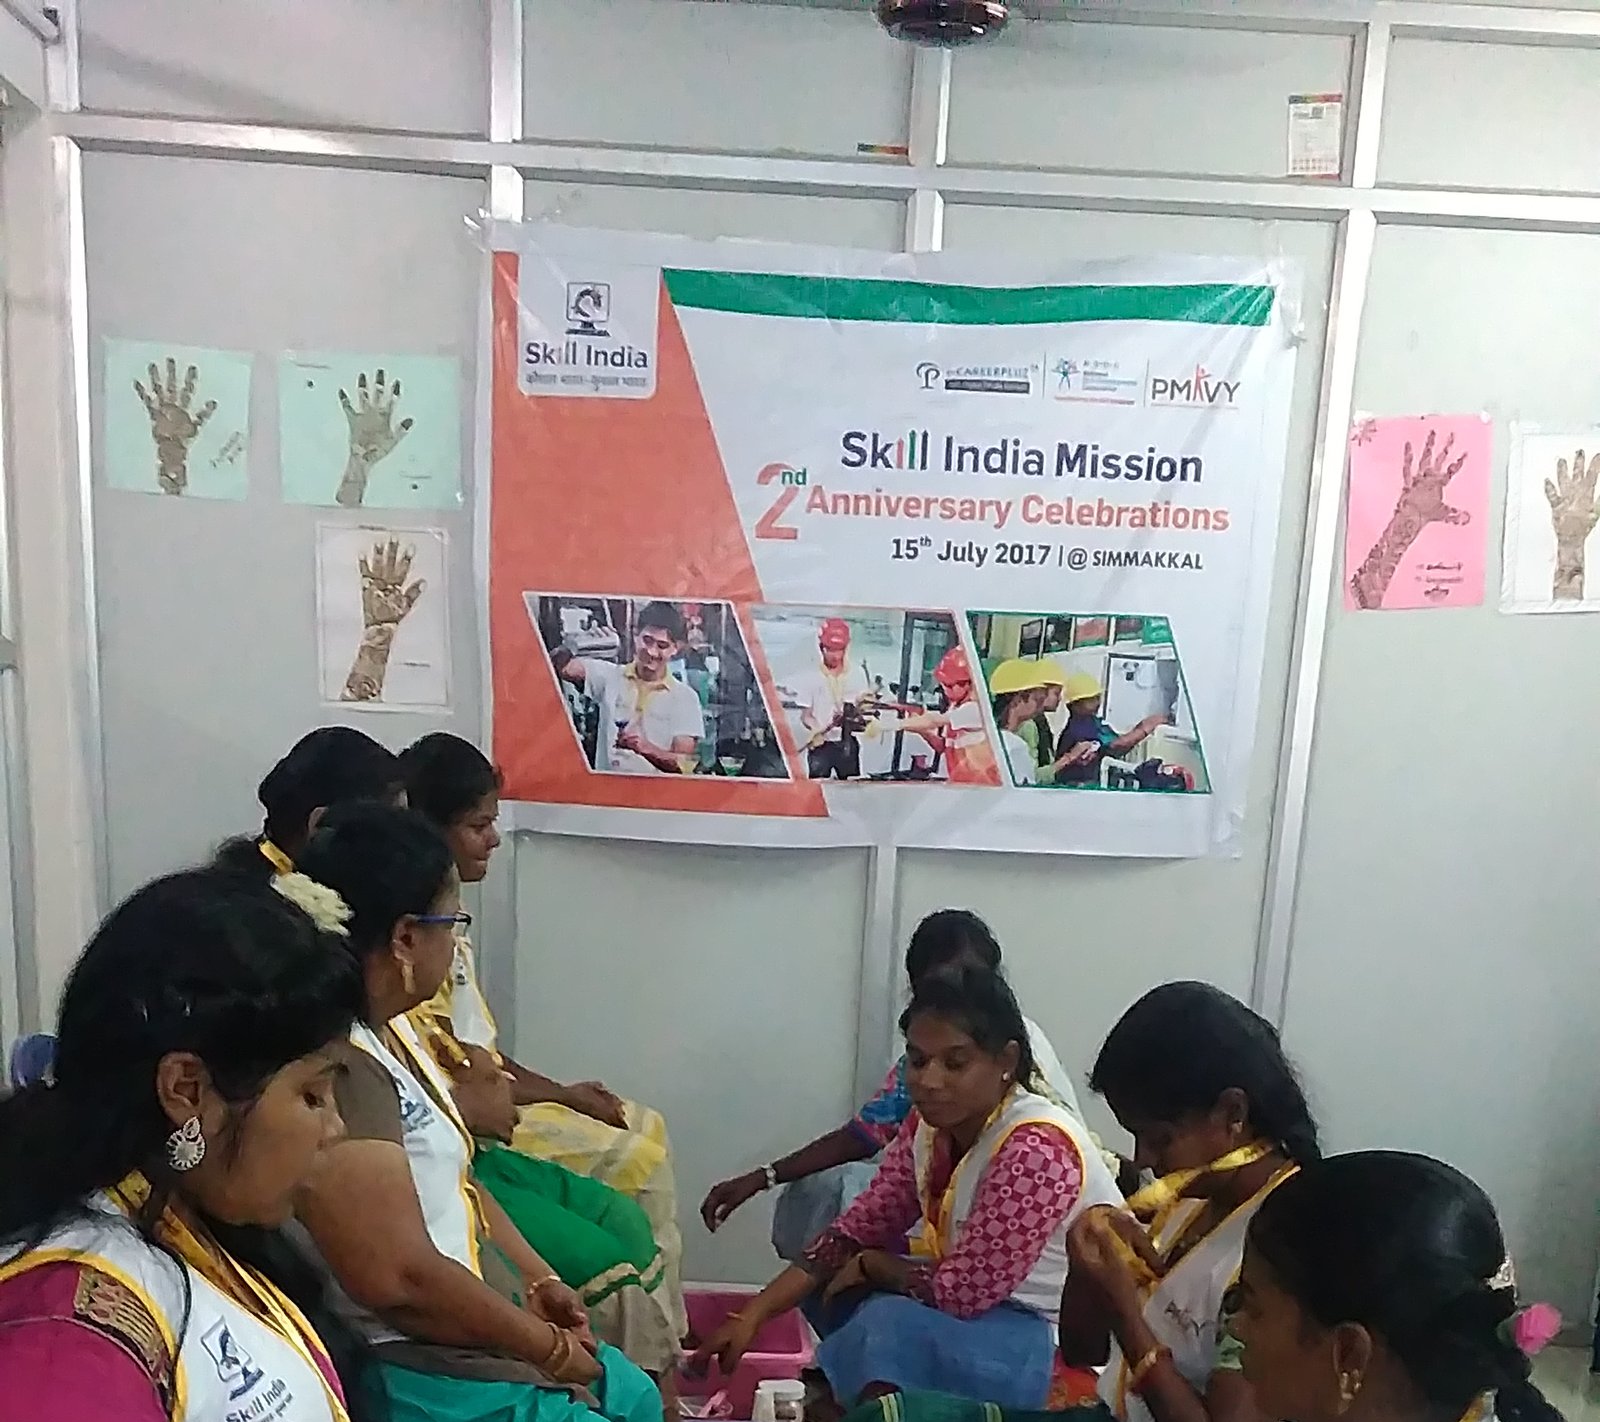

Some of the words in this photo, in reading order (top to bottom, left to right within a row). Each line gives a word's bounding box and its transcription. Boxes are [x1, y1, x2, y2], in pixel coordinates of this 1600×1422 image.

[525, 340, 577, 365] Skill
[586, 344, 648, 368] India
[841, 428, 928, 471] Skill
[944, 434, 1045, 476] India
[1055, 442, 1203, 483] Mission
[805, 484, 1013, 530] Anniversary
[1021, 494, 1230, 532] Celebrations
[890, 535, 932, 560] 15th
[937, 540, 988, 568] July
[994, 542, 1051, 565] 2017
[1092, 550, 1203, 570] SIMMAKKAL
